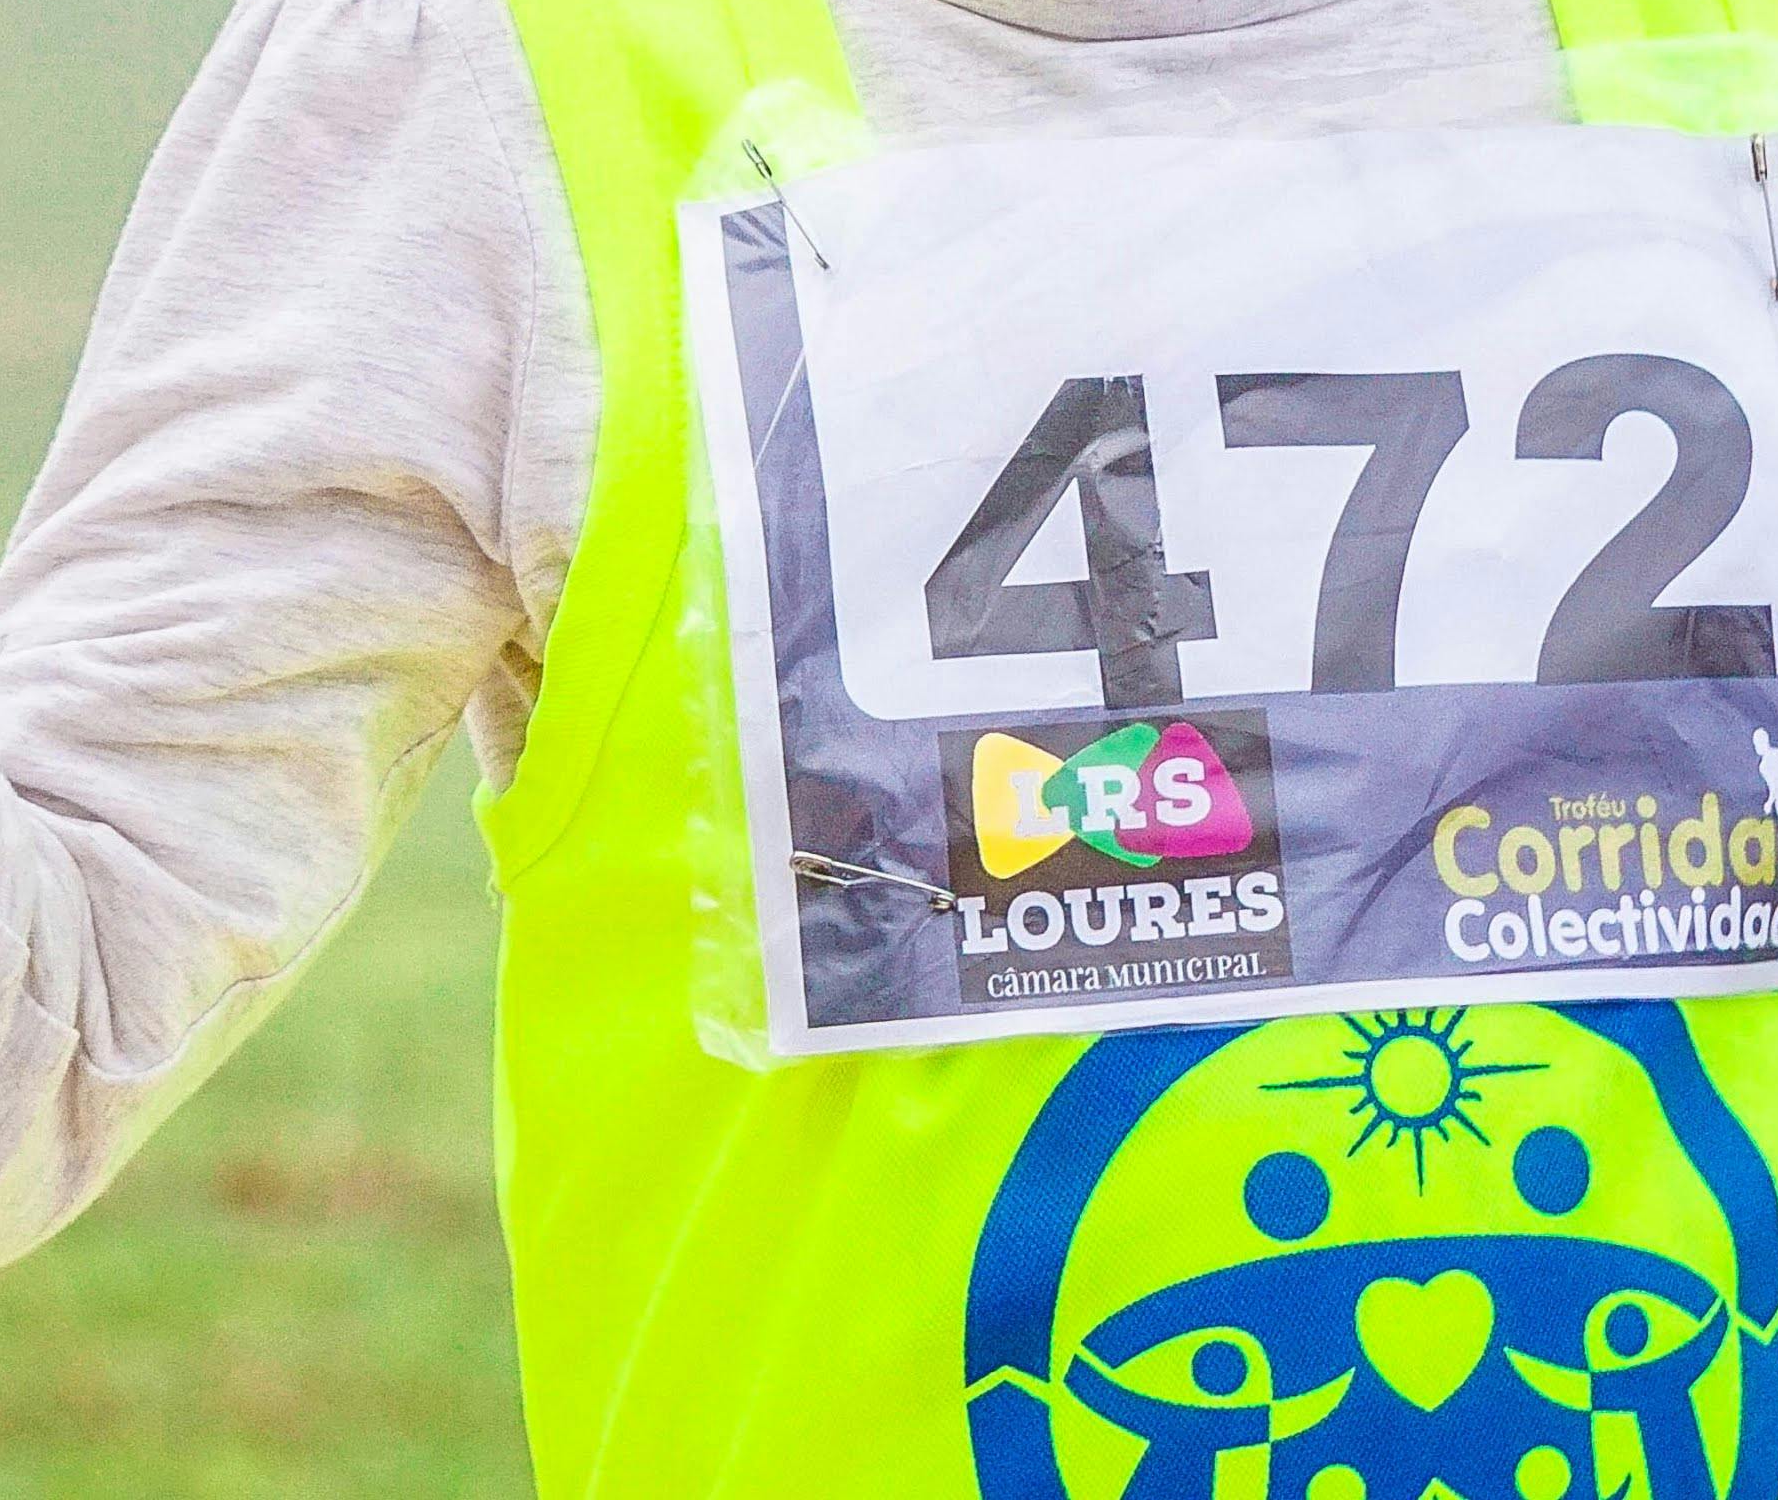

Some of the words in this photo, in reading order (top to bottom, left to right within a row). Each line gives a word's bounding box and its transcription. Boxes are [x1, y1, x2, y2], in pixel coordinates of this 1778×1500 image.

[924, 353, 1777, 710] 472
[1010, 756, 1212, 837] LRS
[1549, 792, 1626, 821] Troféu
[1433, 791, 1777, 898] Corrida
[956, 870, 1285, 956] LOURES
